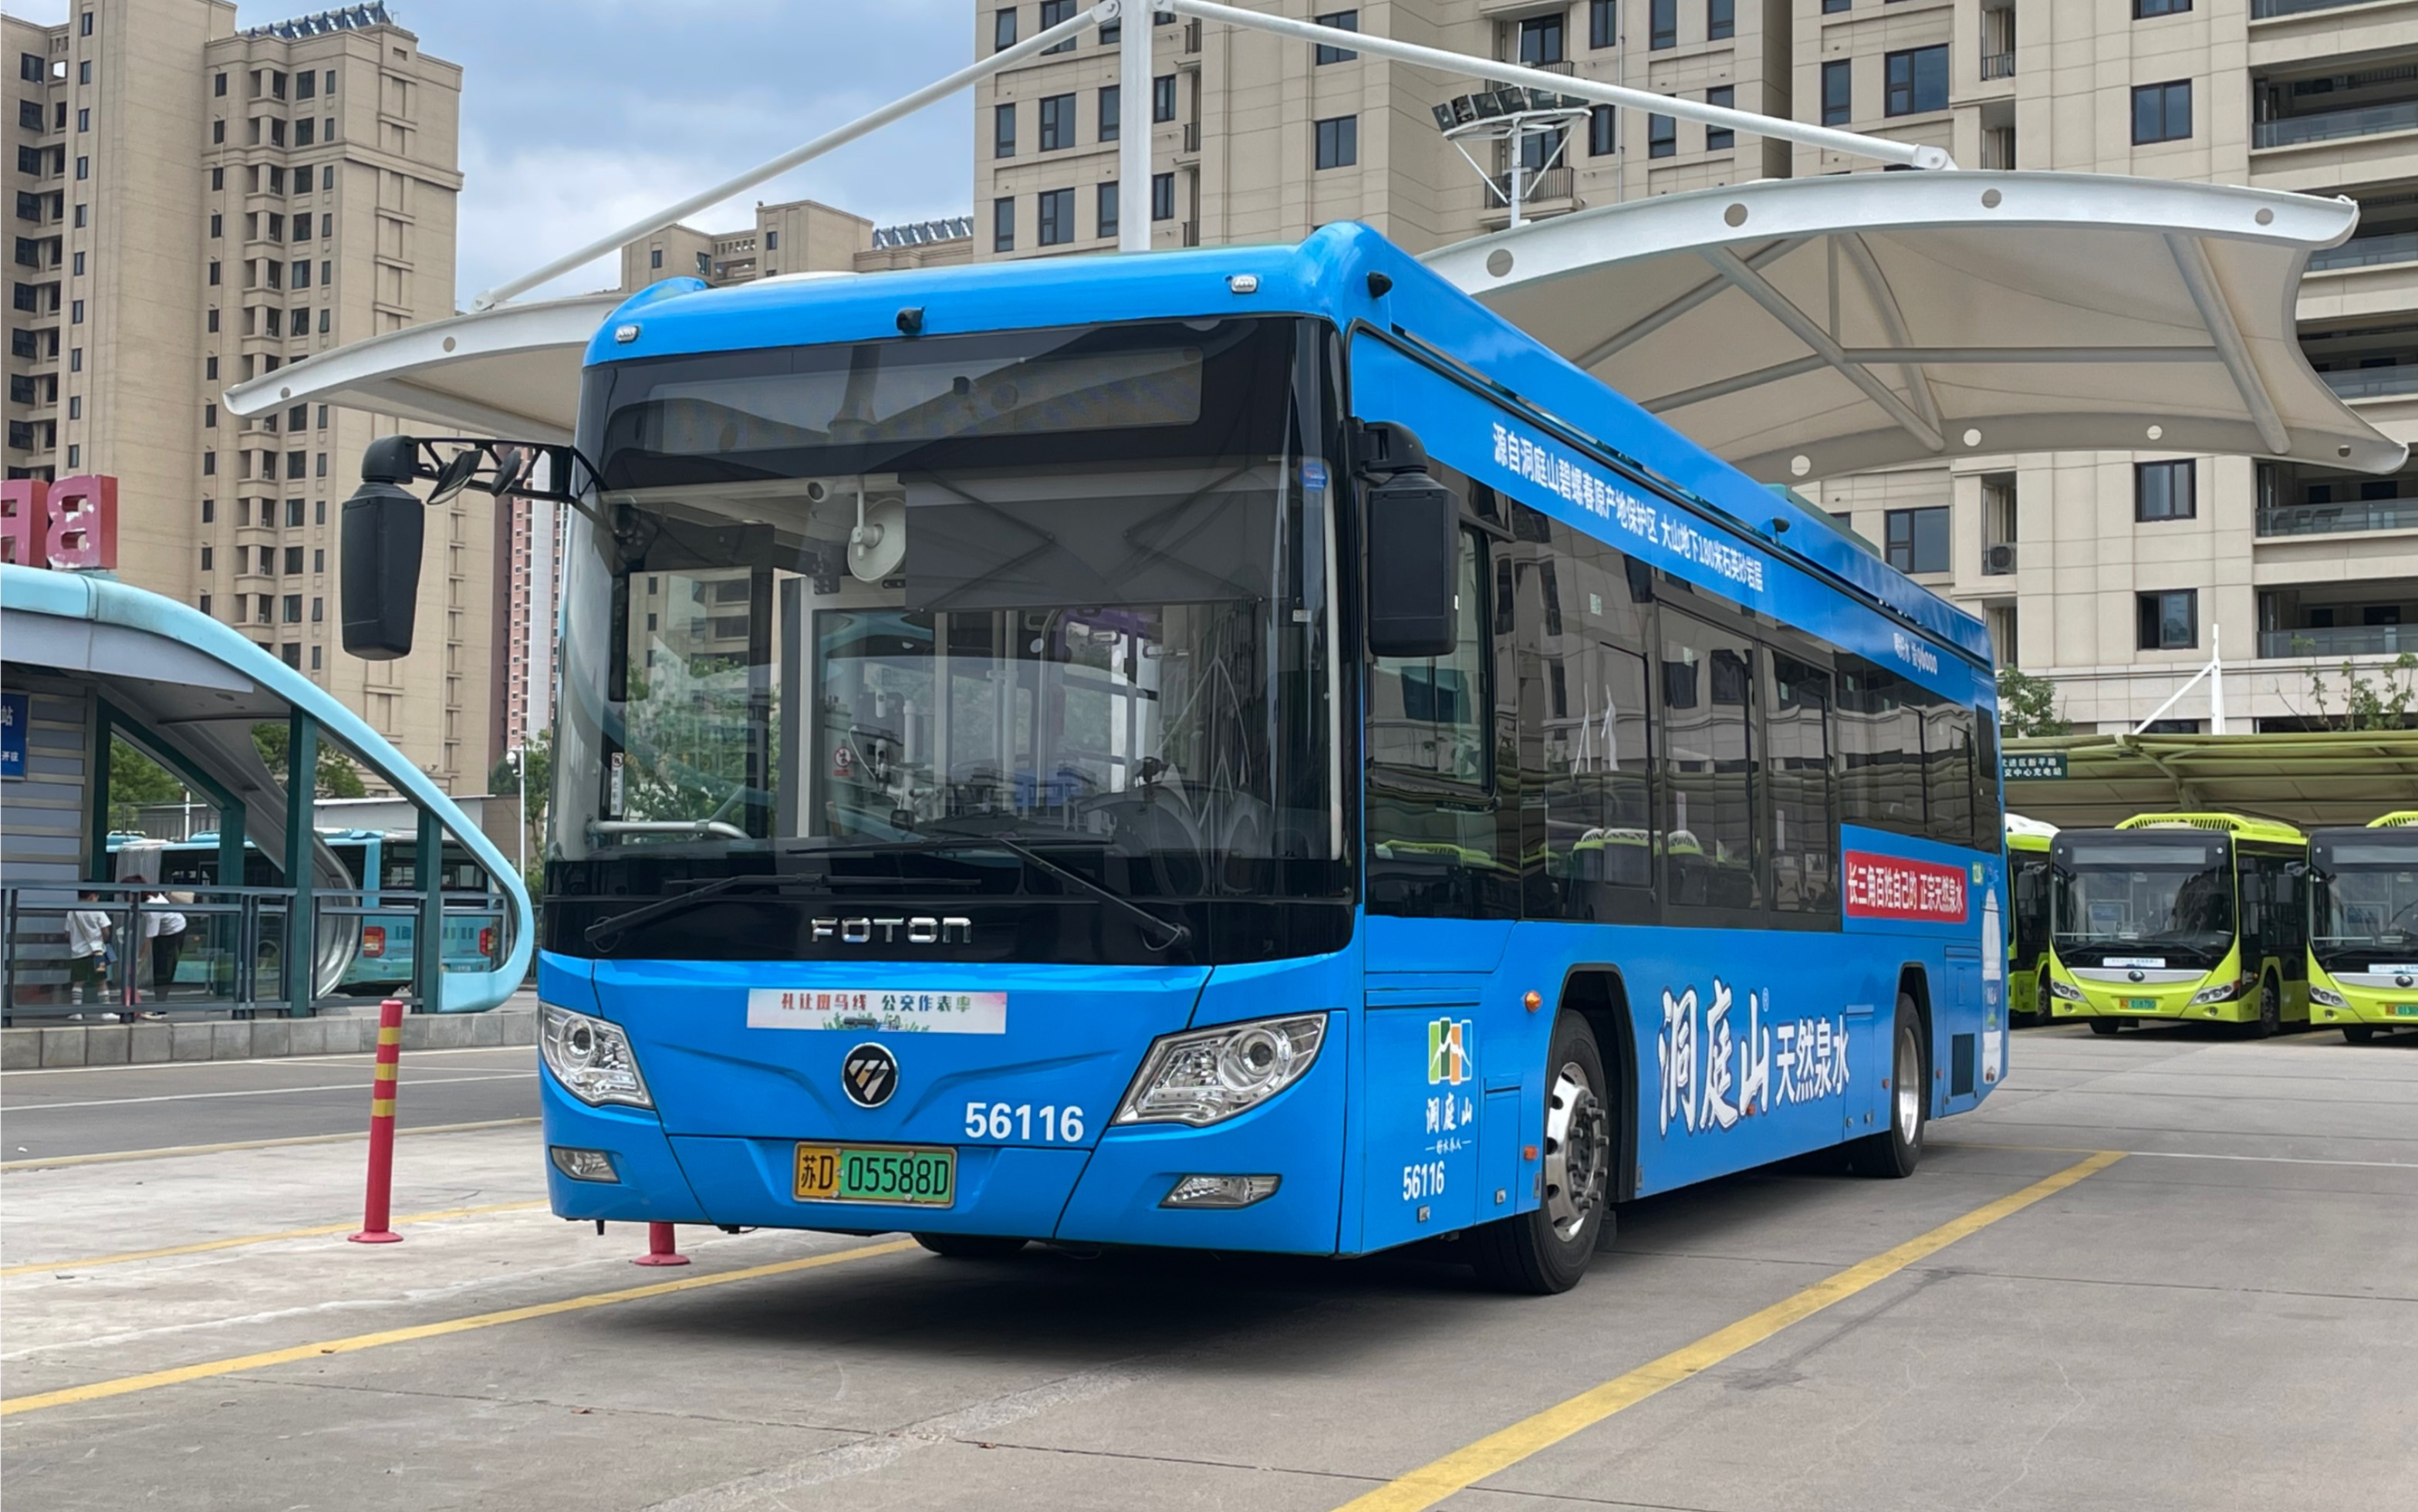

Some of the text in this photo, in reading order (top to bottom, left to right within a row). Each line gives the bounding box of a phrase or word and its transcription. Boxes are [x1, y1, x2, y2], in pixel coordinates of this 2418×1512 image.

[1492, 421, 1659, 545] 源自洞庭山碧螺春原产地保护区
[1848, 862, 1917, 911] 长三角百姓自己的
[1920, 872, 1964, 915] 正宗天然泉水
[811, 916, 971, 943] FOTON
[781, 992, 971, 1013] 礼让斑马线 公交作表率
[1775, 1013, 1850, 1106] 天然泉水
[964, 1102, 1084, 1143] 56116
[1402, 1159, 1445, 1202] 56116
